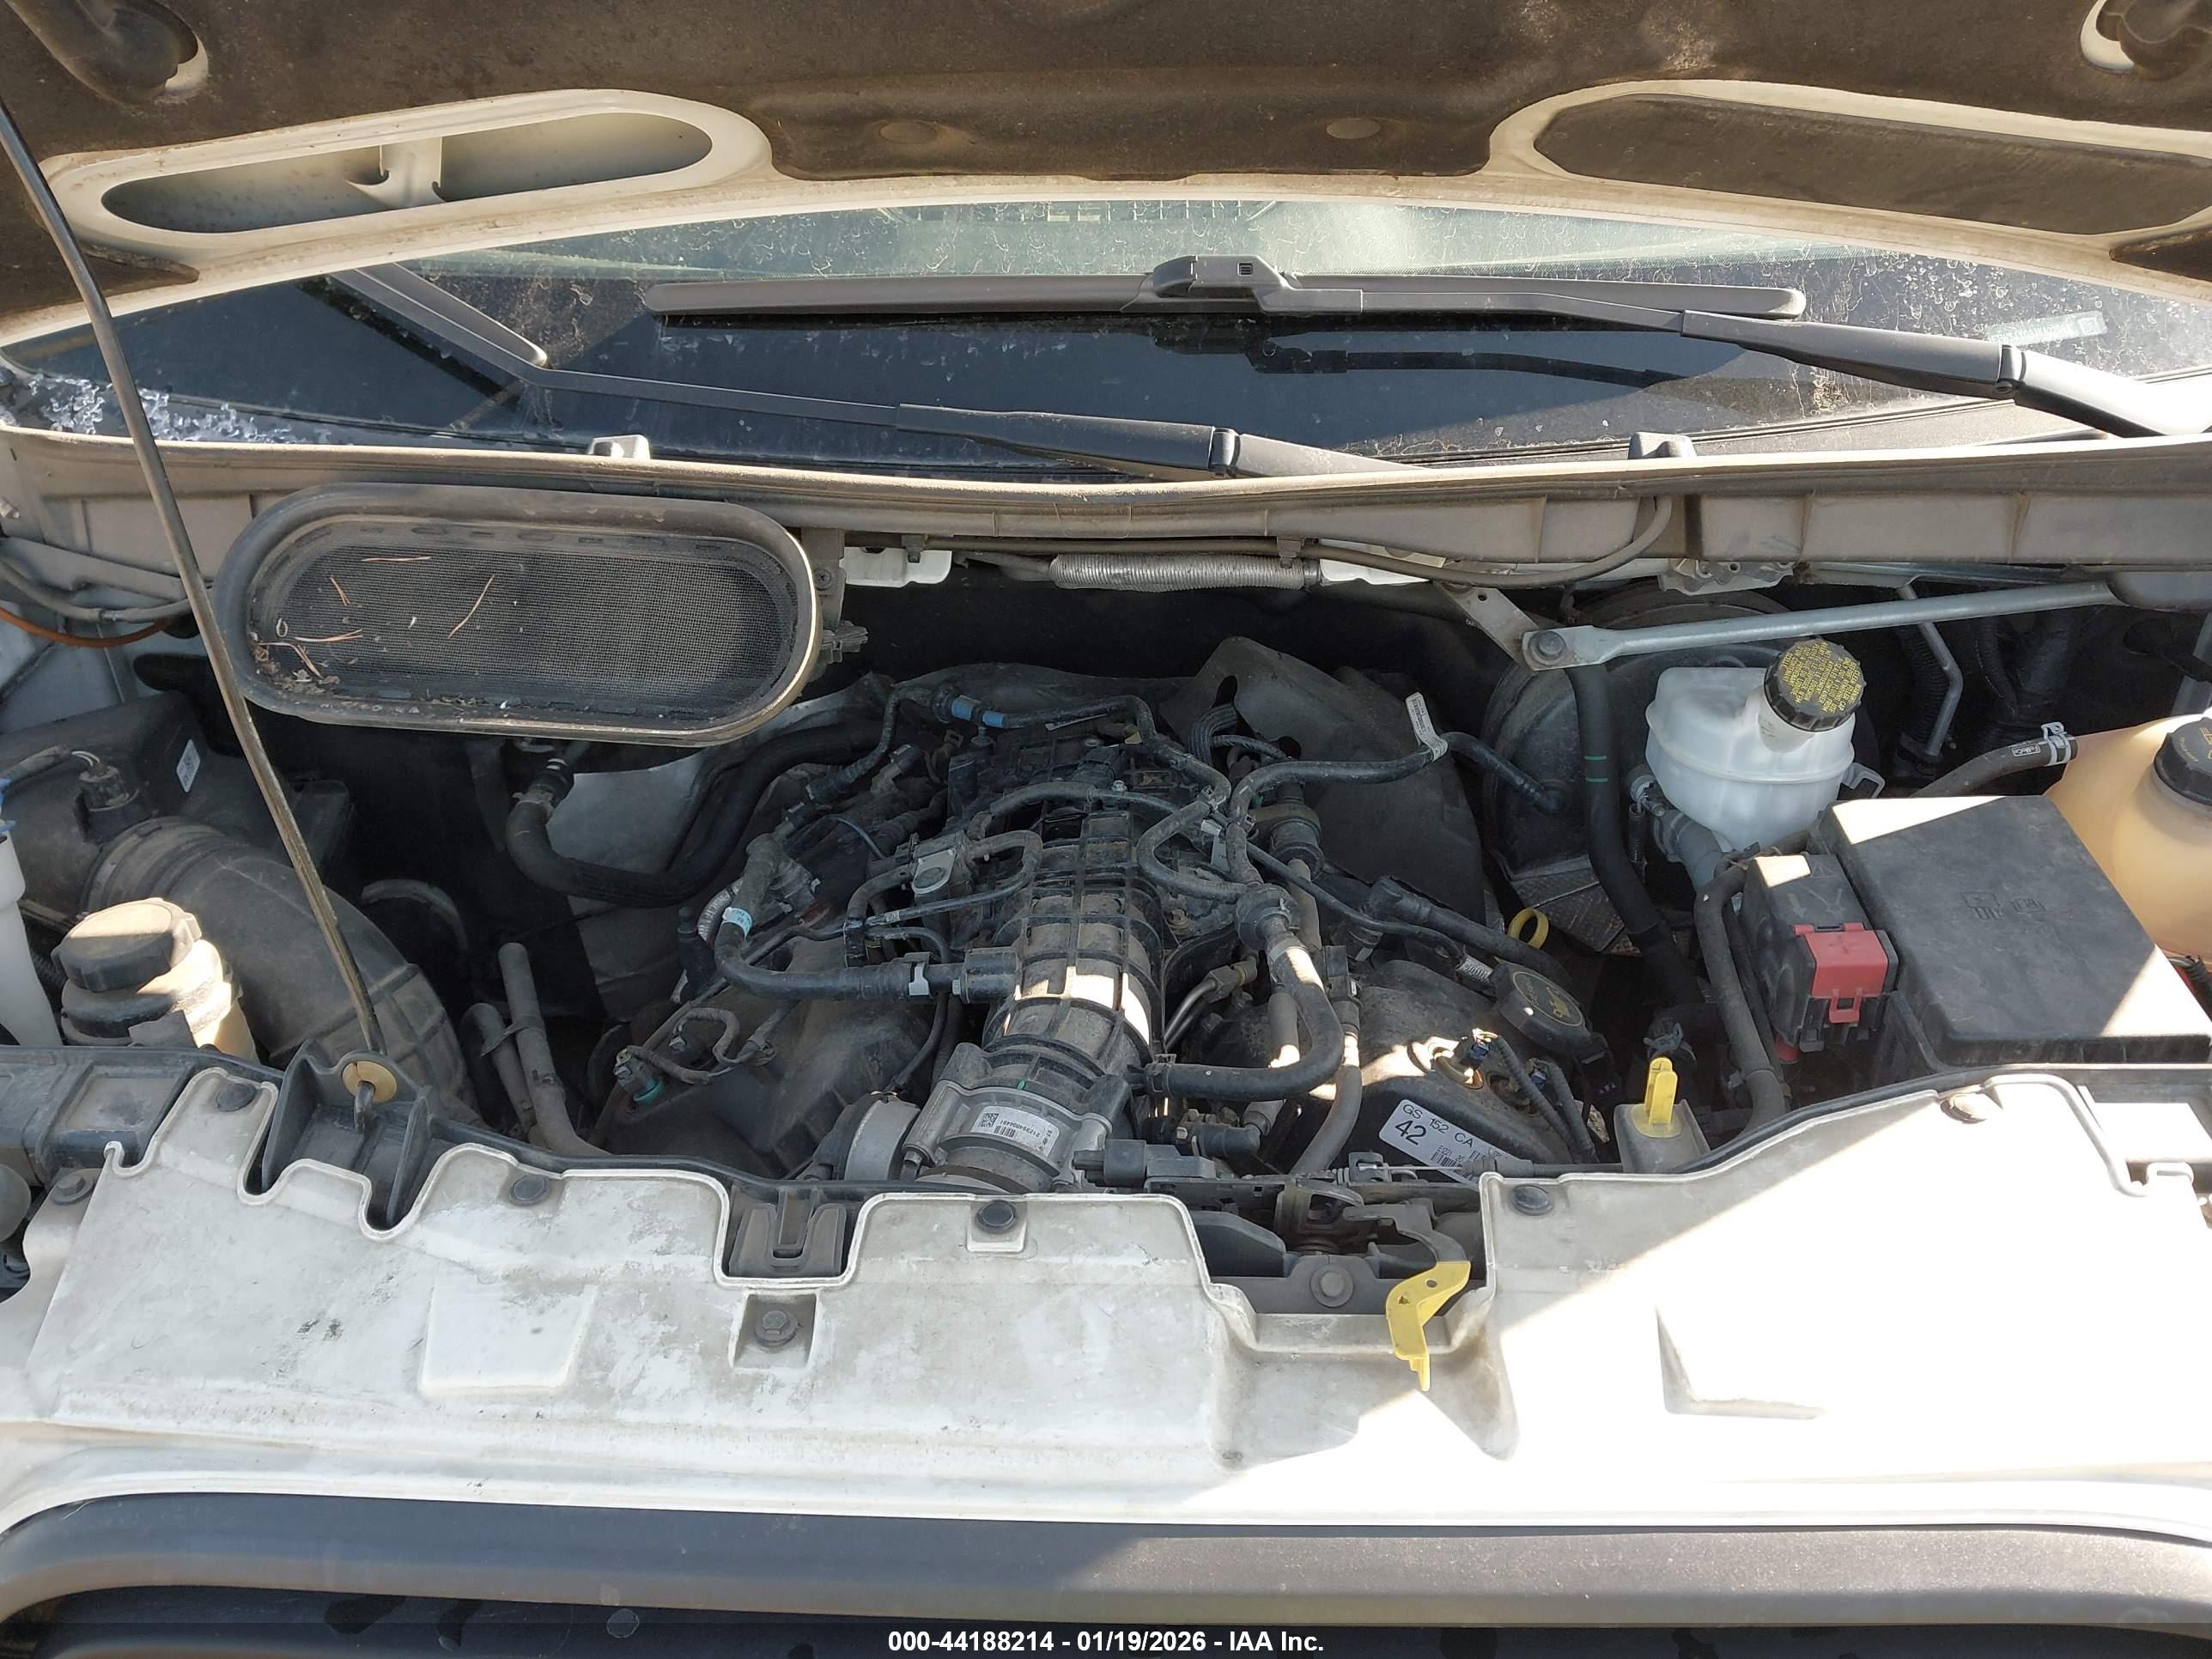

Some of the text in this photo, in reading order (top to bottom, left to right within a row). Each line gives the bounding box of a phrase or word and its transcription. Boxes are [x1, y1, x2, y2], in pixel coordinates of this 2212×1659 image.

[1838, 701, 1846, 711] CAP
[1395, 1120, 1427, 1146] 42
[1402, 1104, 1474, 1148] GS 152 CA
